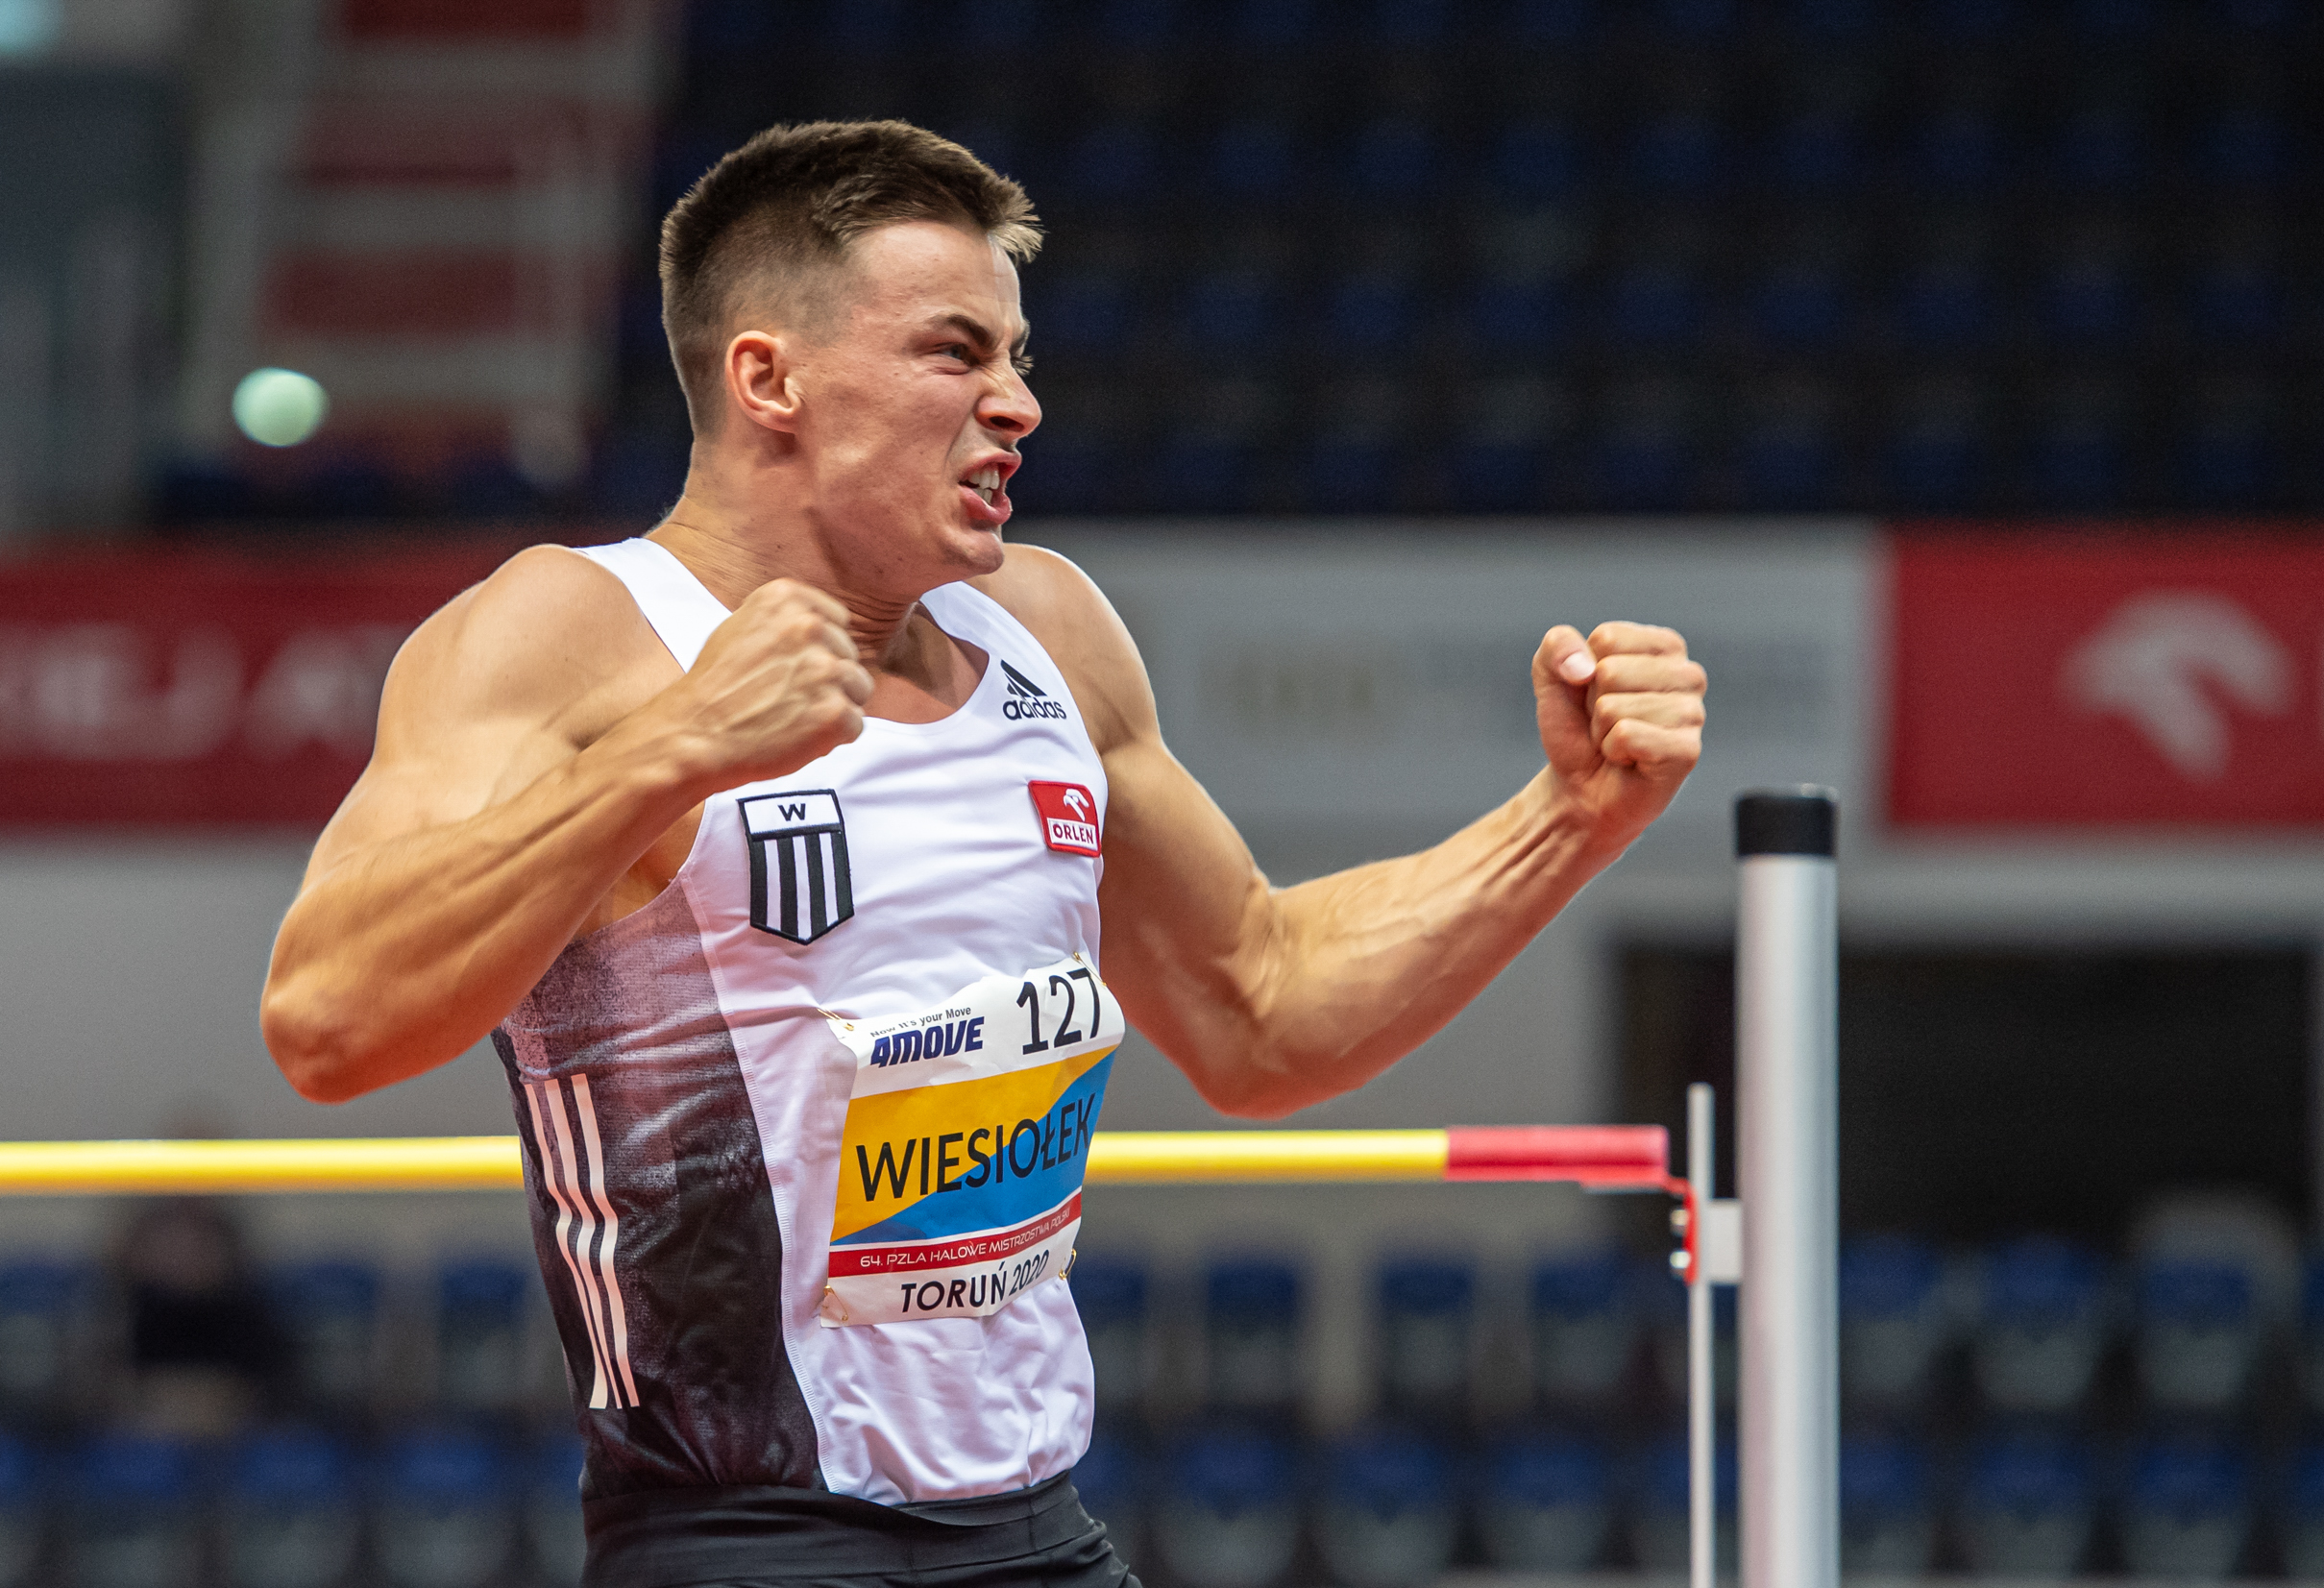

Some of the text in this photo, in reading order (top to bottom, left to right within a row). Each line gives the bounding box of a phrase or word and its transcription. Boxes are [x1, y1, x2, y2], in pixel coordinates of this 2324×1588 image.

[1002, 696, 1067, 721] adidas
[777, 802, 807, 822] W
[1052, 823, 1094, 845] ORLEN
[870, 1026, 896, 1038] Now
[918, 1013, 943, 1027] your
[945, 1007, 971, 1020] Move
[1016, 967, 1101, 1055] 127
[869, 1016, 985, 1068] 4MOVE
[856, 1092, 1096, 1202] WIESIOŁEK
[860, 1208, 1070, 1268] 64. PZLA HALOWE MISTRZOSTWA POLSKI
[901, 1249, 1050, 1313] TORUŃ 2020
